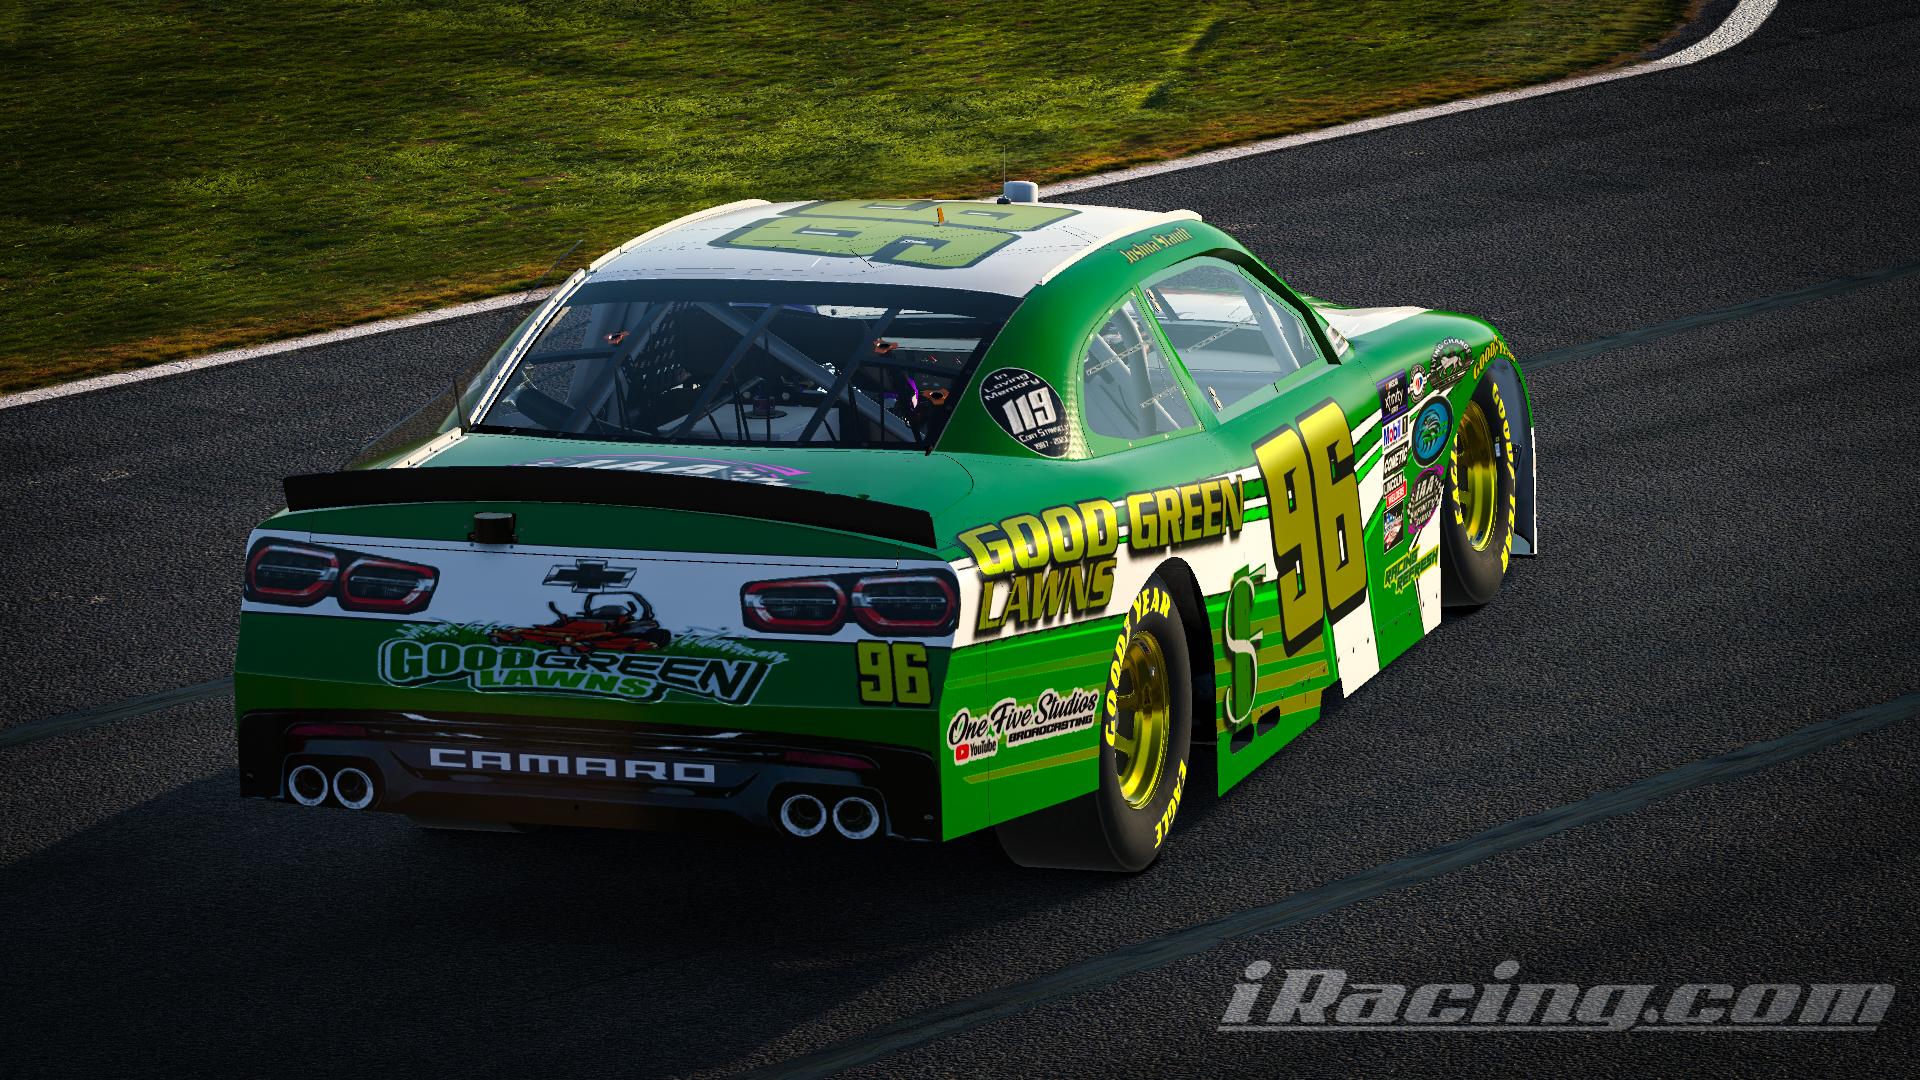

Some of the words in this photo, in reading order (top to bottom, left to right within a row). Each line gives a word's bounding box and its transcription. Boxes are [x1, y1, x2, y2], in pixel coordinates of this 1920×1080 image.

[1119, 243, 1161, 264] Joshua
[1443, 338, 1472, 354] CHANGE
[984, 372, 1030, 393] Loving
[984, 378, 1040, 401] Memory
[993, 373, 1008, 381] In
[1001, 386, 1057, 435] 119
[1383, 419, 1401, 447] Mobil
[1384, 472, 1404, 497] LINCOLN
[957, 496, 1121, 578] GOOD
[1126, 474, 1245, 551] GREEN
[1251, 398, 1368, 658] 96
[1384, 544, 1420, 588] RACING
[1395, 544, 1439, 594] REFRESH
[976, 556, 1118, 632] LAWNS
[389, 638, 536, 683] GOOD
[534, 647, 770, 705] GREEN
[480, 668, 659, 698] LAWNS
[856, 639, 933, 706] 96
[1104, 587, 1171, 747] GOODYEAR
[948, 712, 989, 745] One
[990, 702, 1033, 735] Five
[1034, 691, 1099, 725] Studios
[1008, 714, 1094, 743] BROADCASTING
[430, 748, 715, 783] CAMARO
[970, 740, 997, 756] YouTube
[1153, 758, 1188, 849] EAGLE
